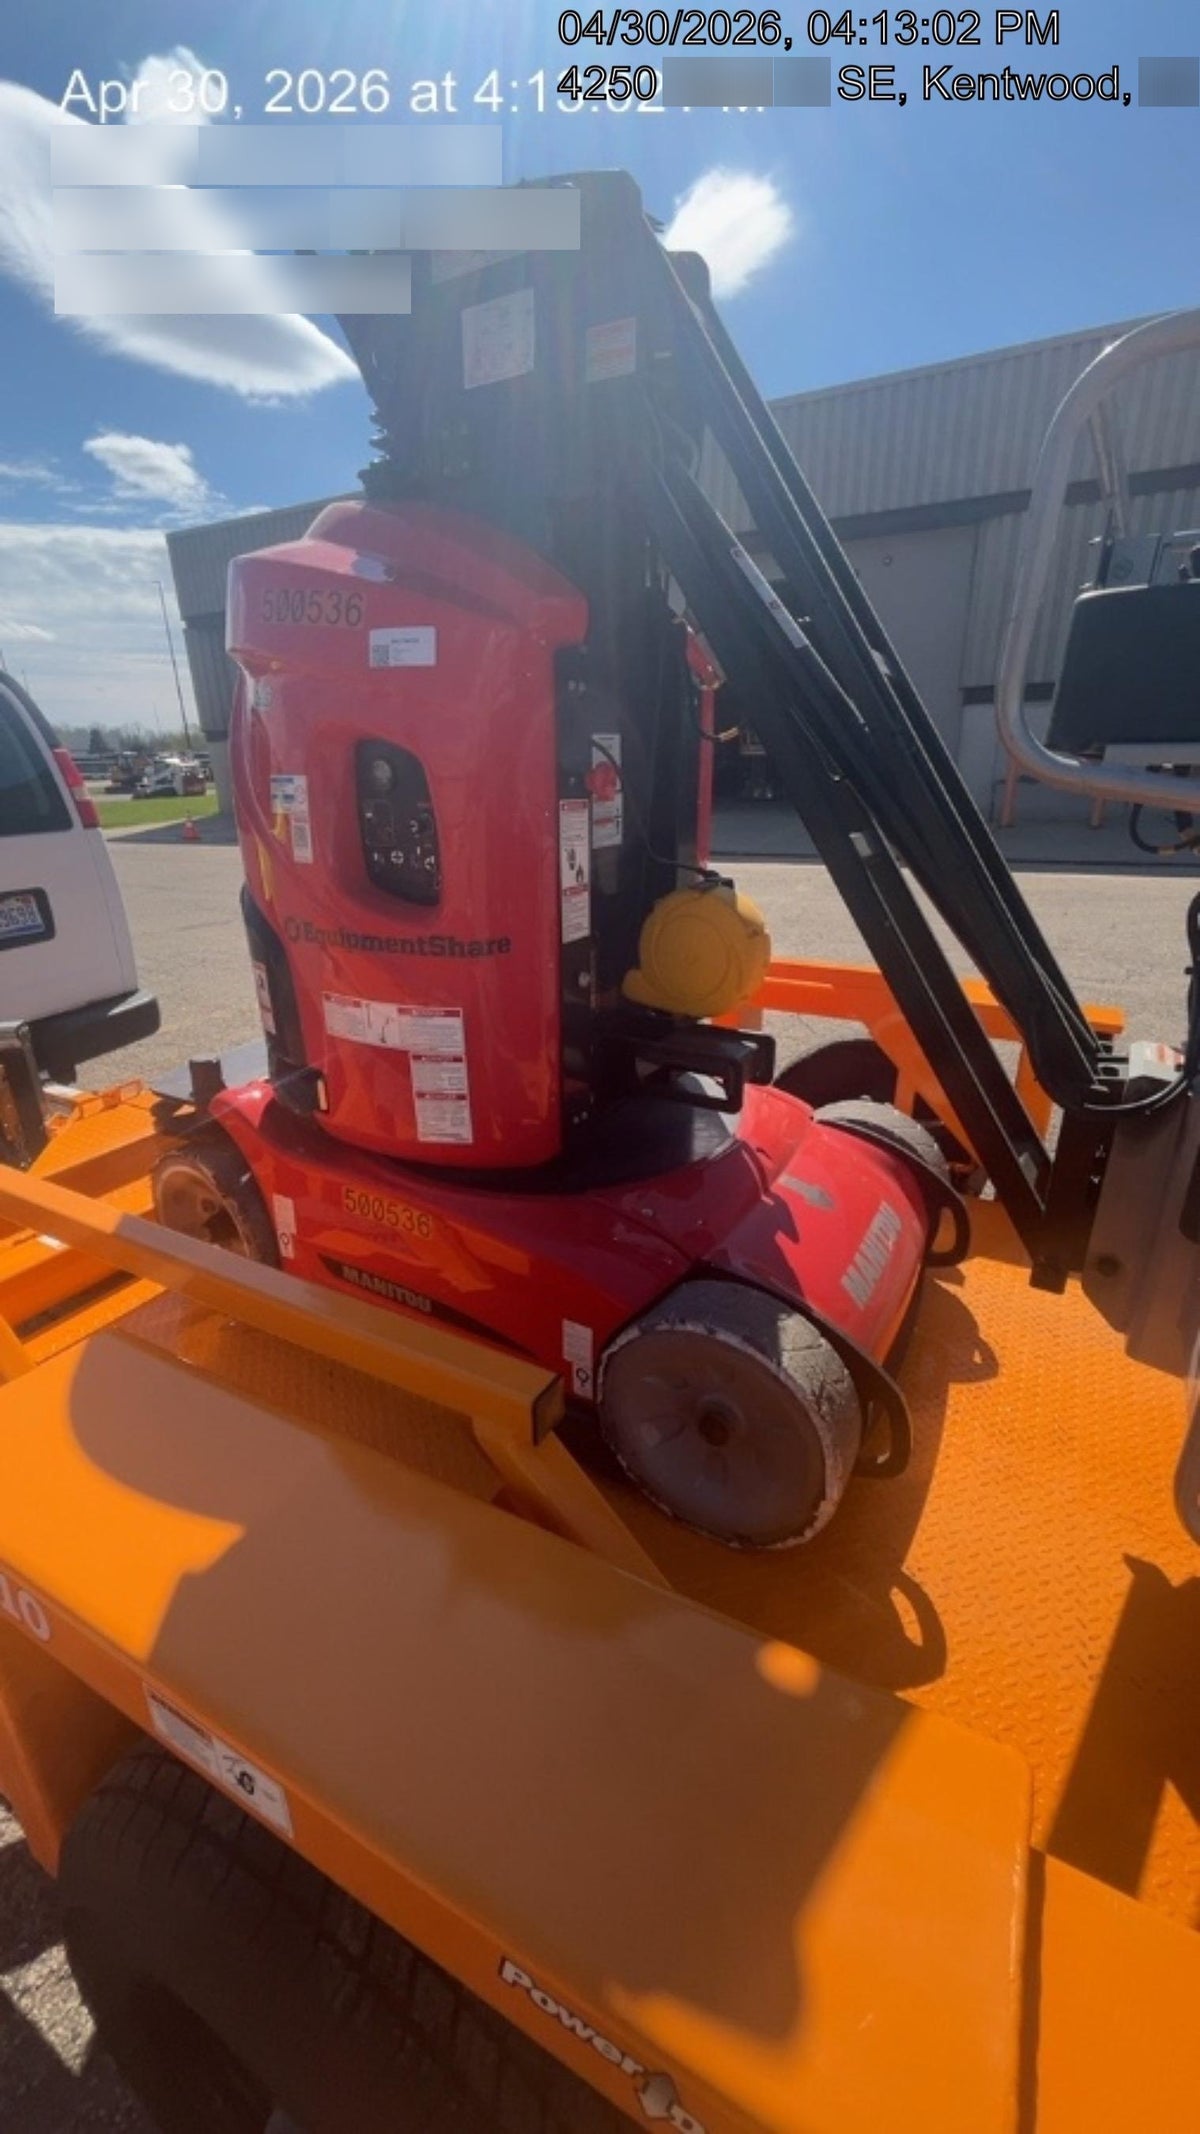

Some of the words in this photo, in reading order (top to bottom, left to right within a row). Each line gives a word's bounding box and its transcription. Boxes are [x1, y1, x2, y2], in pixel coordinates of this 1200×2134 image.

[262, 587, 363, 627] 500536
[302, 920, 512, 958] EquipmentShare
[344, 1186, 431, 1239] 500536
[840, 1200, 902, 1311] MANITOU
[341, 1264, 433, 1313] MANITOU
[500, 1957, 646, 2076] Power
